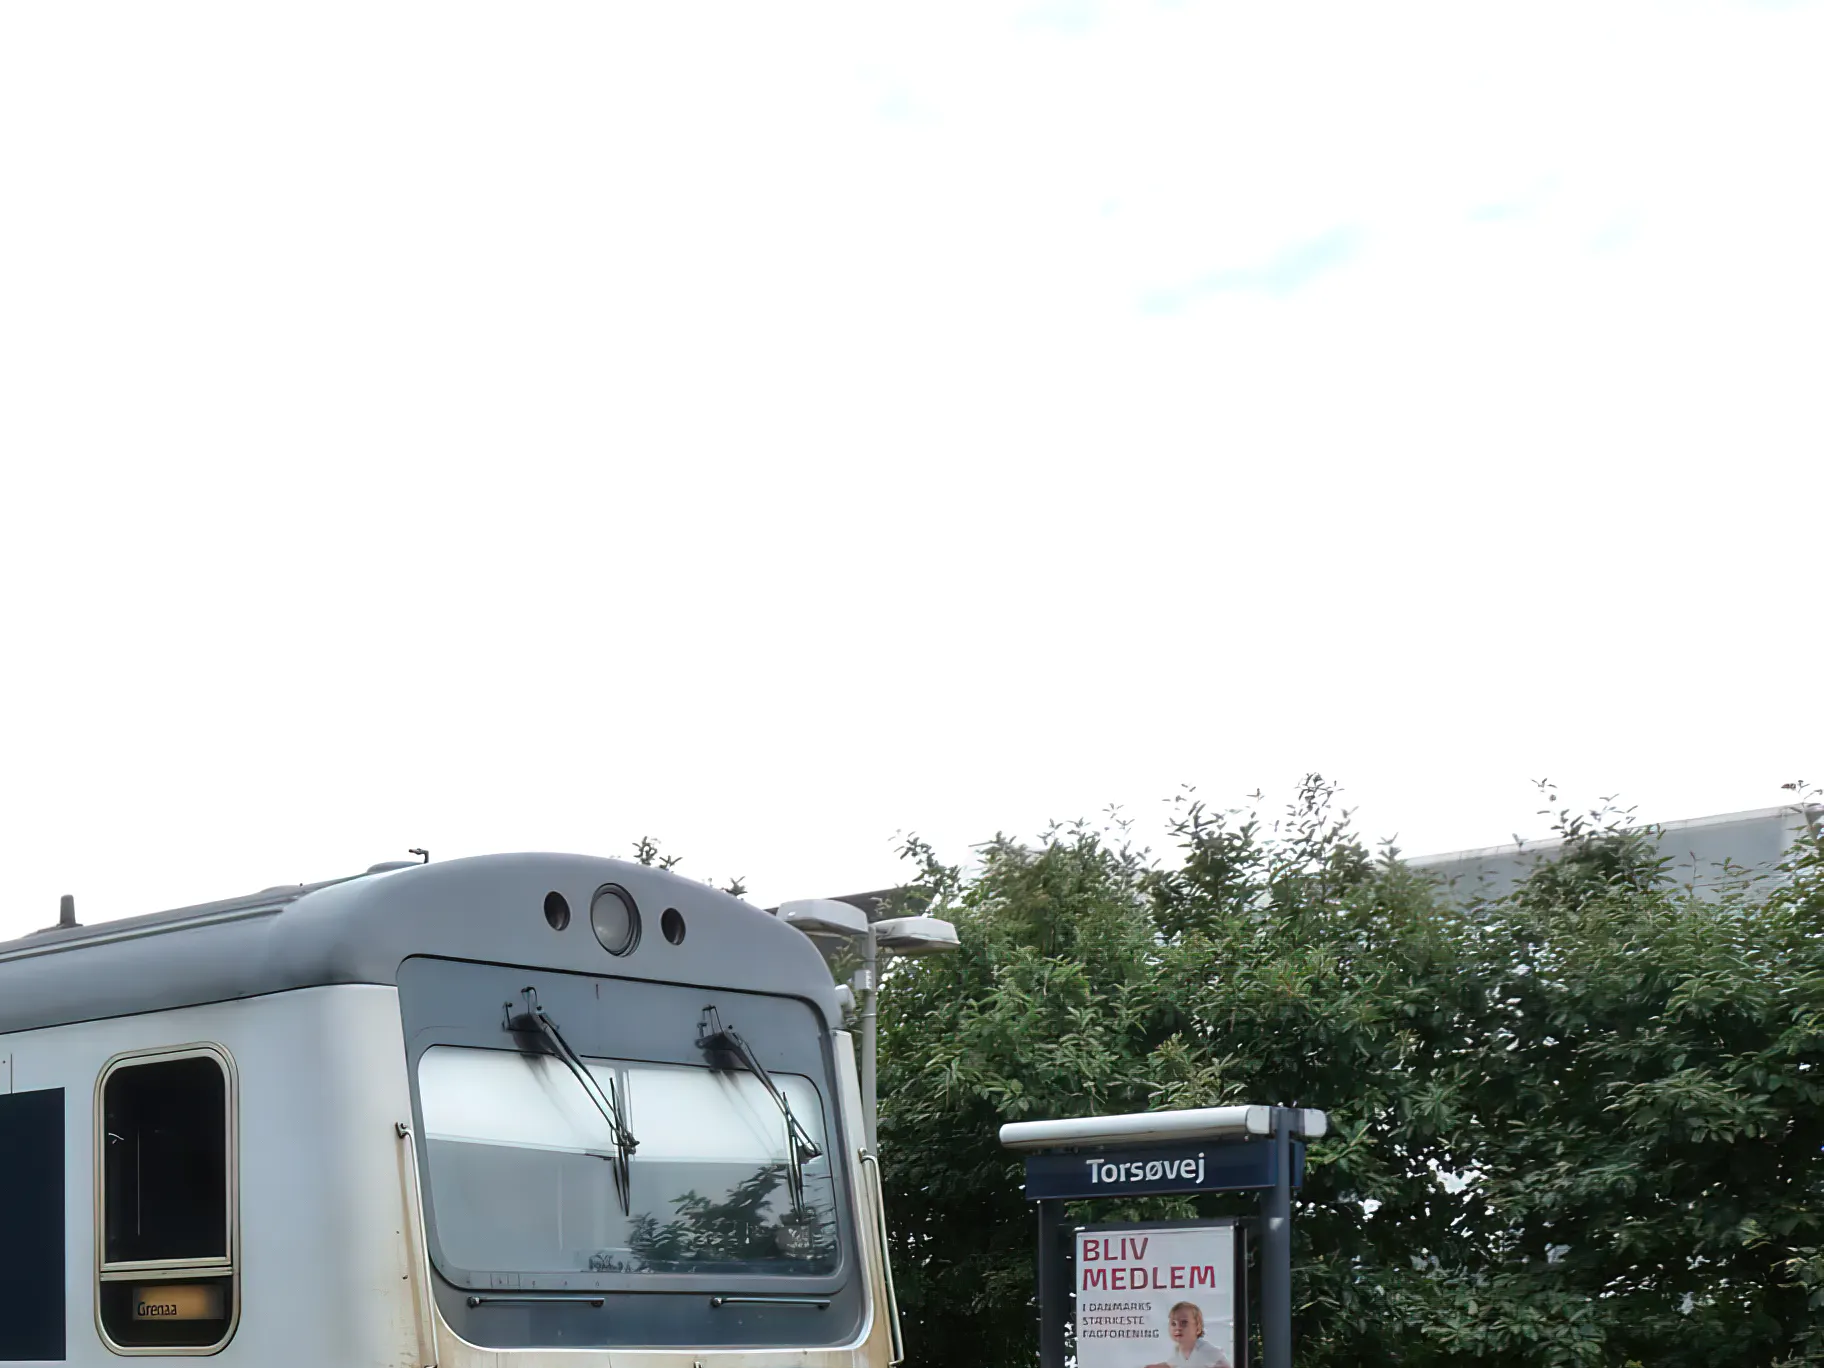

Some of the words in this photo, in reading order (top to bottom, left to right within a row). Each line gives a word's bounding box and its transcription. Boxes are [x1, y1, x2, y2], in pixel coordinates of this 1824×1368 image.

[1086, 1152, 1207, 1184] Torsøvej
[1082, 1237, 1149, 1262] BLIV
[1082, 1265, 1216, 1291] MEDLEM
[137, 1301, 177, 1316] Grenaa
[1089, 1302, 1152, 1311] DANMARKS
[1082, 1329, 1160, 1338] FAGFORENING
